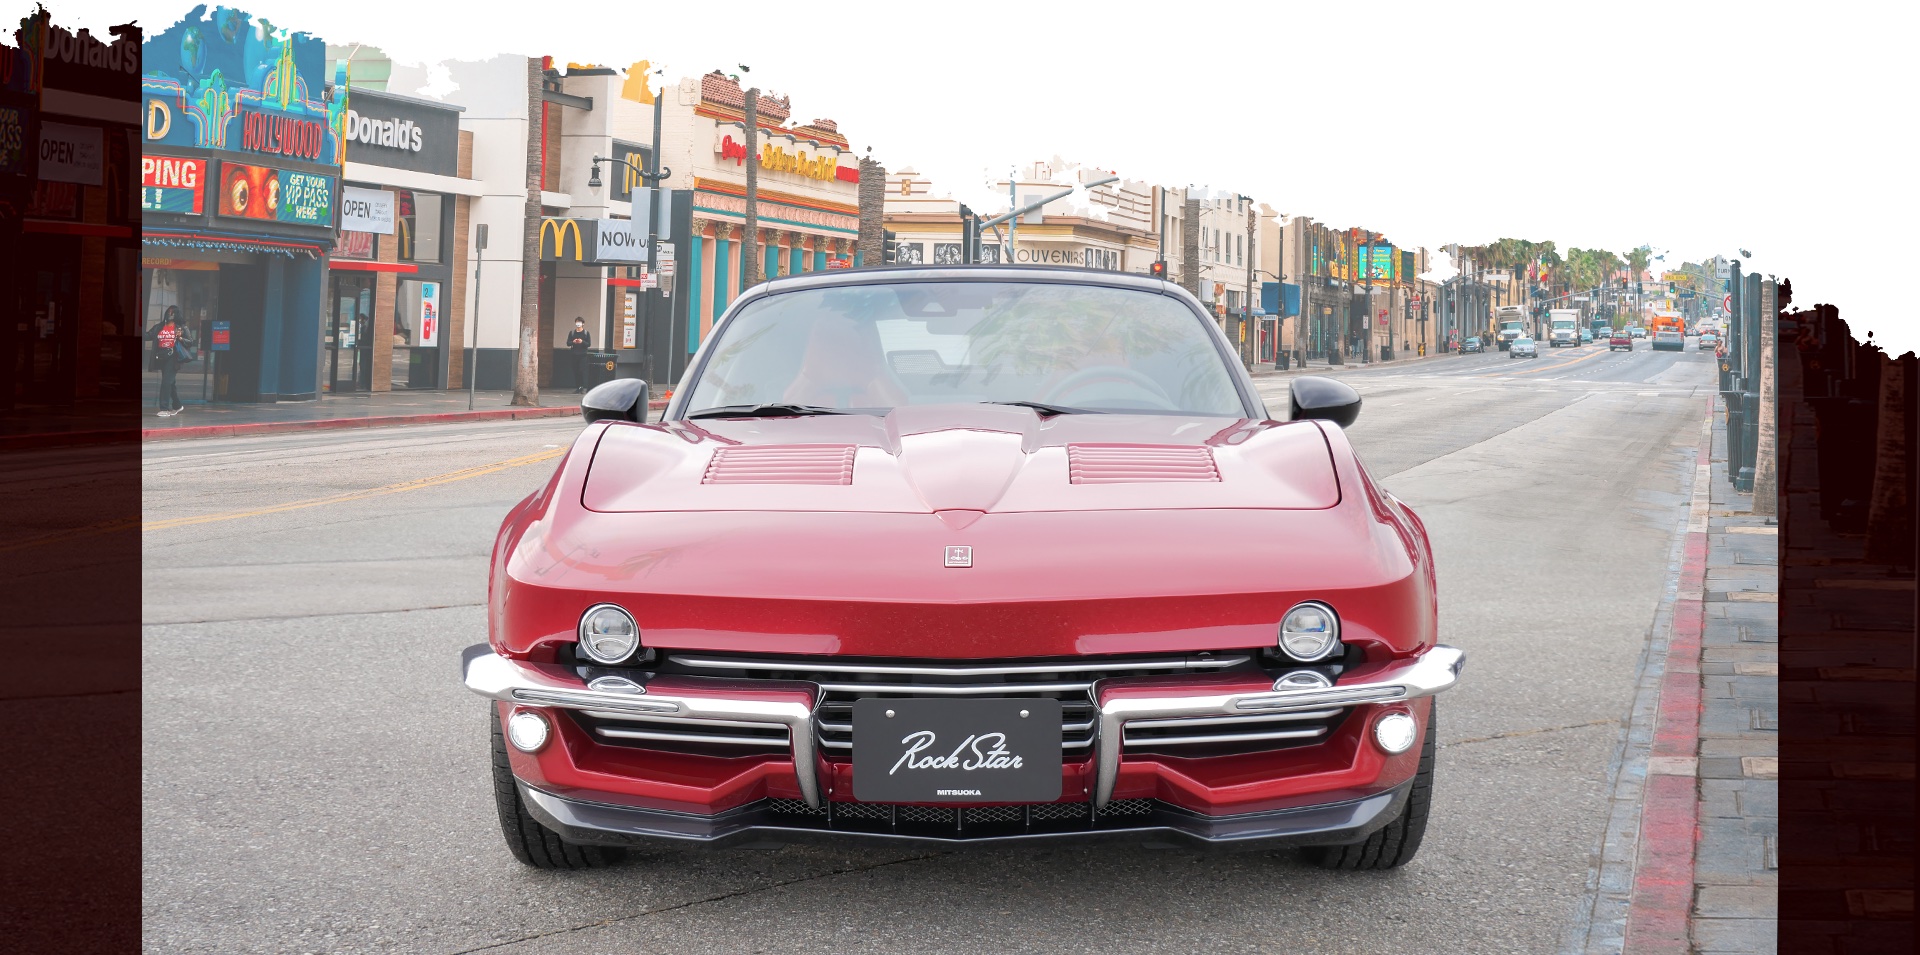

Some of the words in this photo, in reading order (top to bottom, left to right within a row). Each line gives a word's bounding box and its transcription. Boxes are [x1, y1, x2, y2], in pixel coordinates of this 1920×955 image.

[242, 110, 323, 160] HOLLYWOOD
[40, 138, 75, 164] OPEN
[289, 173, 305, 186] GET
[305, 174, 326, 189] YOUR
[285, 184, 302, 205] VIP
[303, 186, 330, 209] PASS
[295, 205, 318, 220] HERE
[343, 199, 371, 219] OPEN
[601, 231, 635, 248] NOW
[1017, 249, 1084, 265] OUVENIRS
[888, 730, 975, 776] Rock
[962, 732, 1024, 771] Star
[936, 788, 982, 797] MITSUOKA
